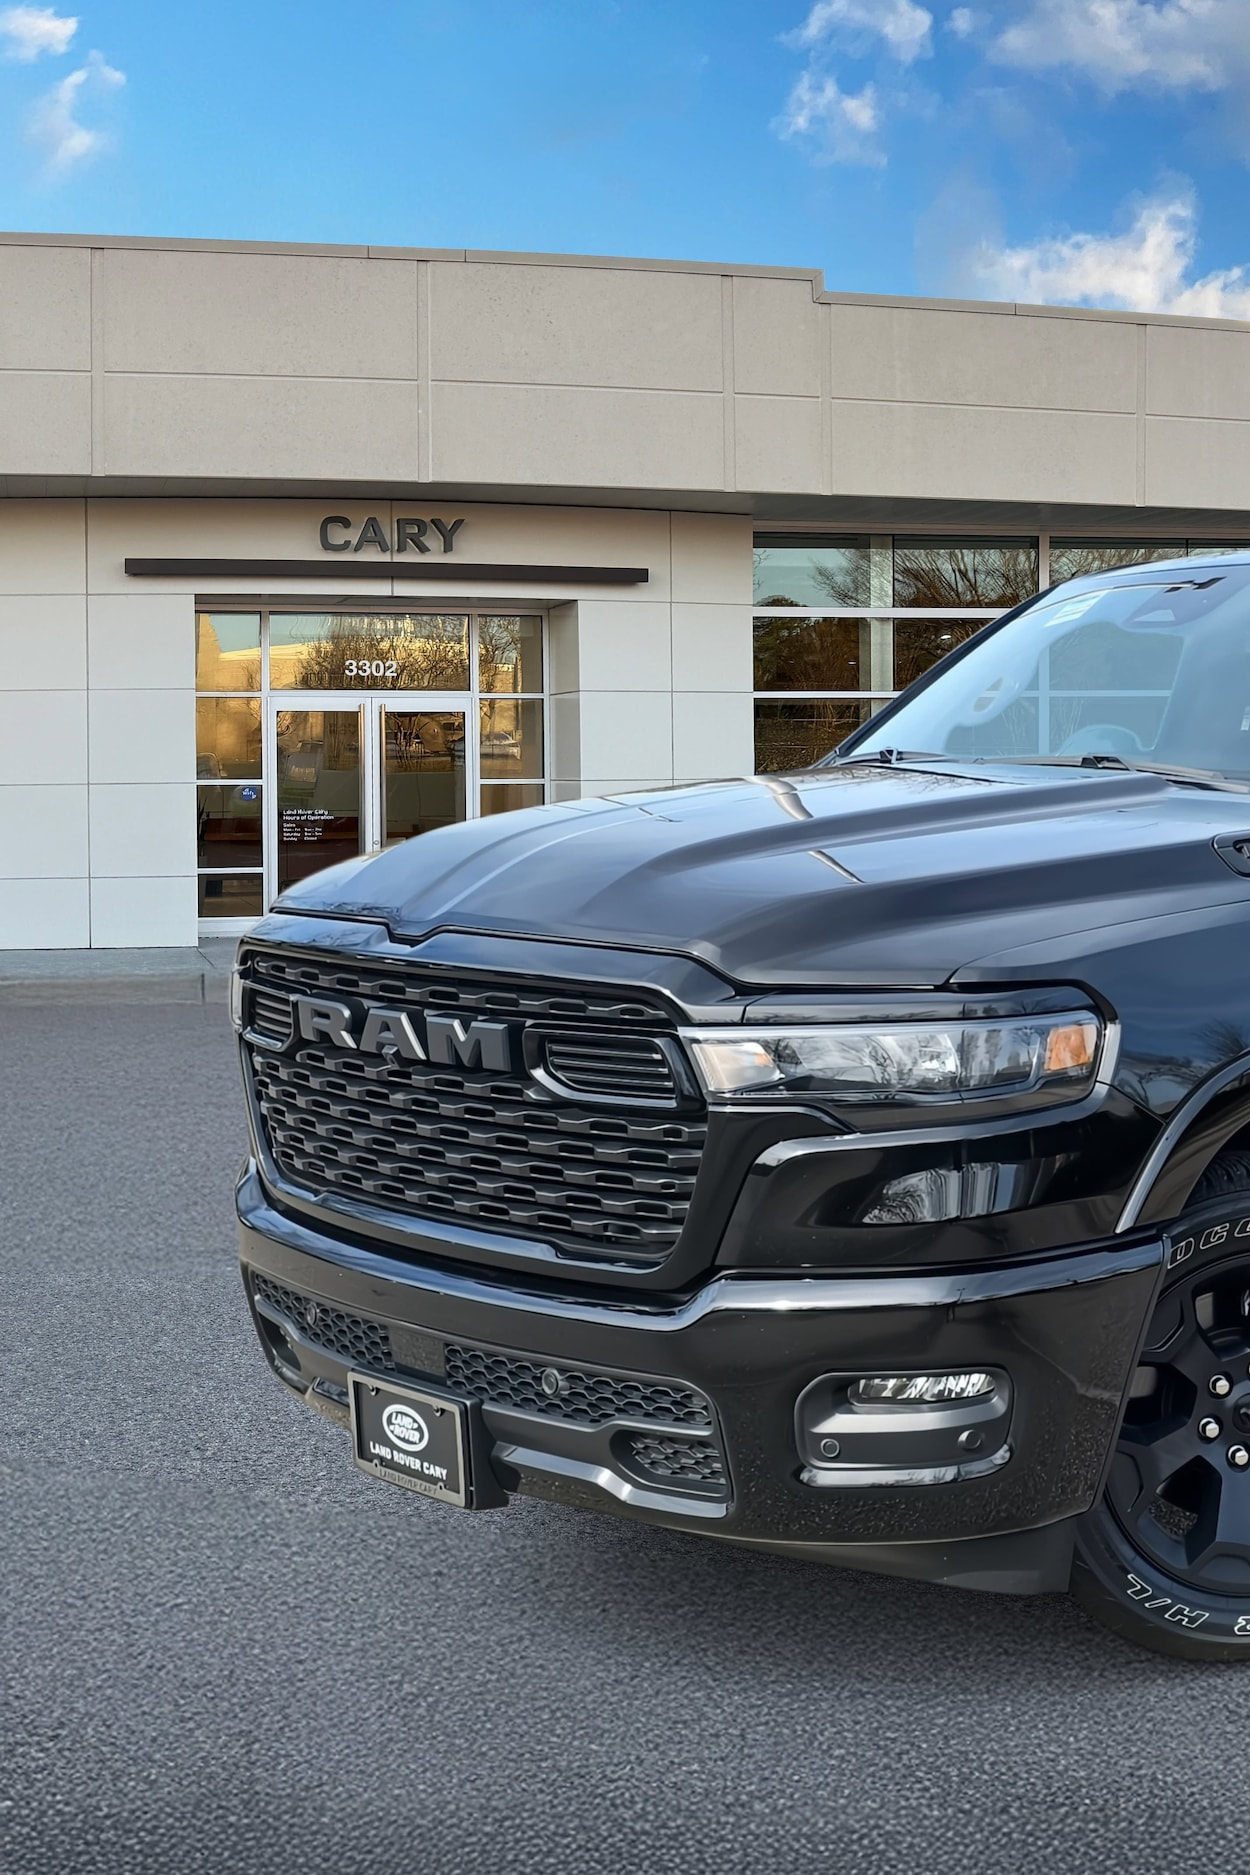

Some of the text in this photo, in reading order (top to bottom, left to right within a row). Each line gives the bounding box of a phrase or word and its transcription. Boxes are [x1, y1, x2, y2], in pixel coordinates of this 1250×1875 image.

[319, 515, 466, 554] CARY
[344, 659, 399, 677] 3302
[298, 997, 513, 1073] RAM
[391, 1412, 414, 1429] LAND
[393, 1424, 420, 1444] ROVER
[369, 1441, 448, 1481] LAND ROVER CARY
[1126, 1573, 1210, 1629] H/L
